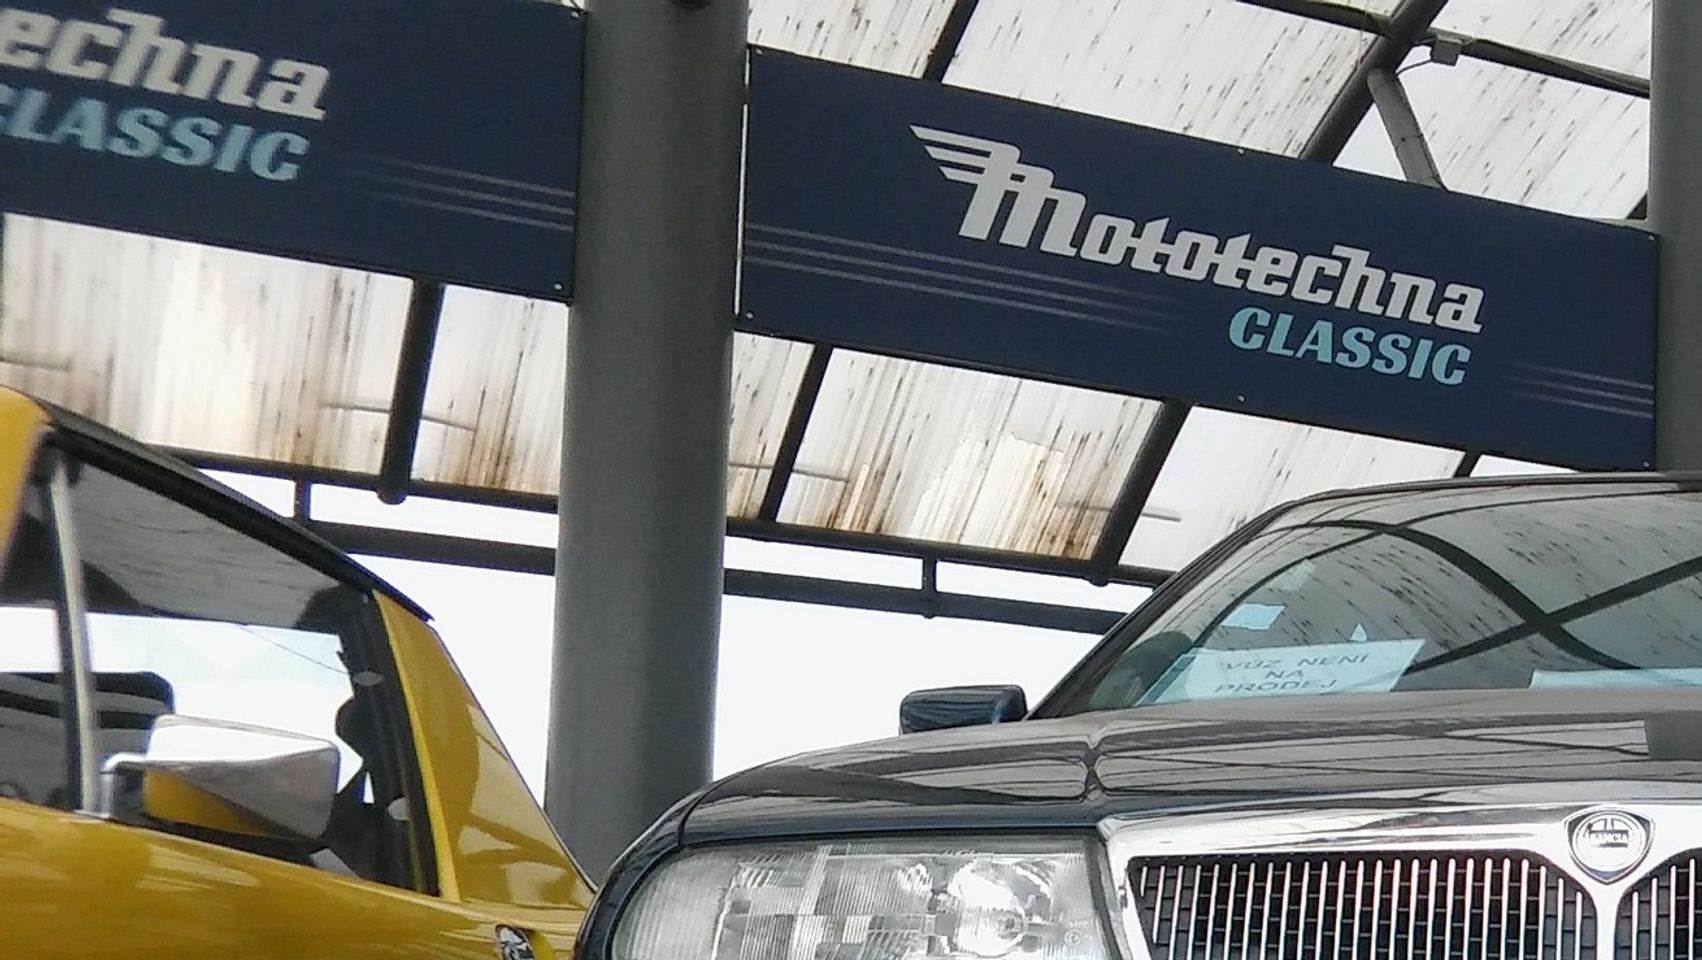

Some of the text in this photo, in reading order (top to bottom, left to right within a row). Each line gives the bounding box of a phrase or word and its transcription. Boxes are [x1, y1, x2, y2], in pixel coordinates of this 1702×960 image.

[0, 82, 310, 182] LASSIC
[910, 124, 1486, 335] Mototechna
[1227, 306, 1473, 388] CLASSIC
